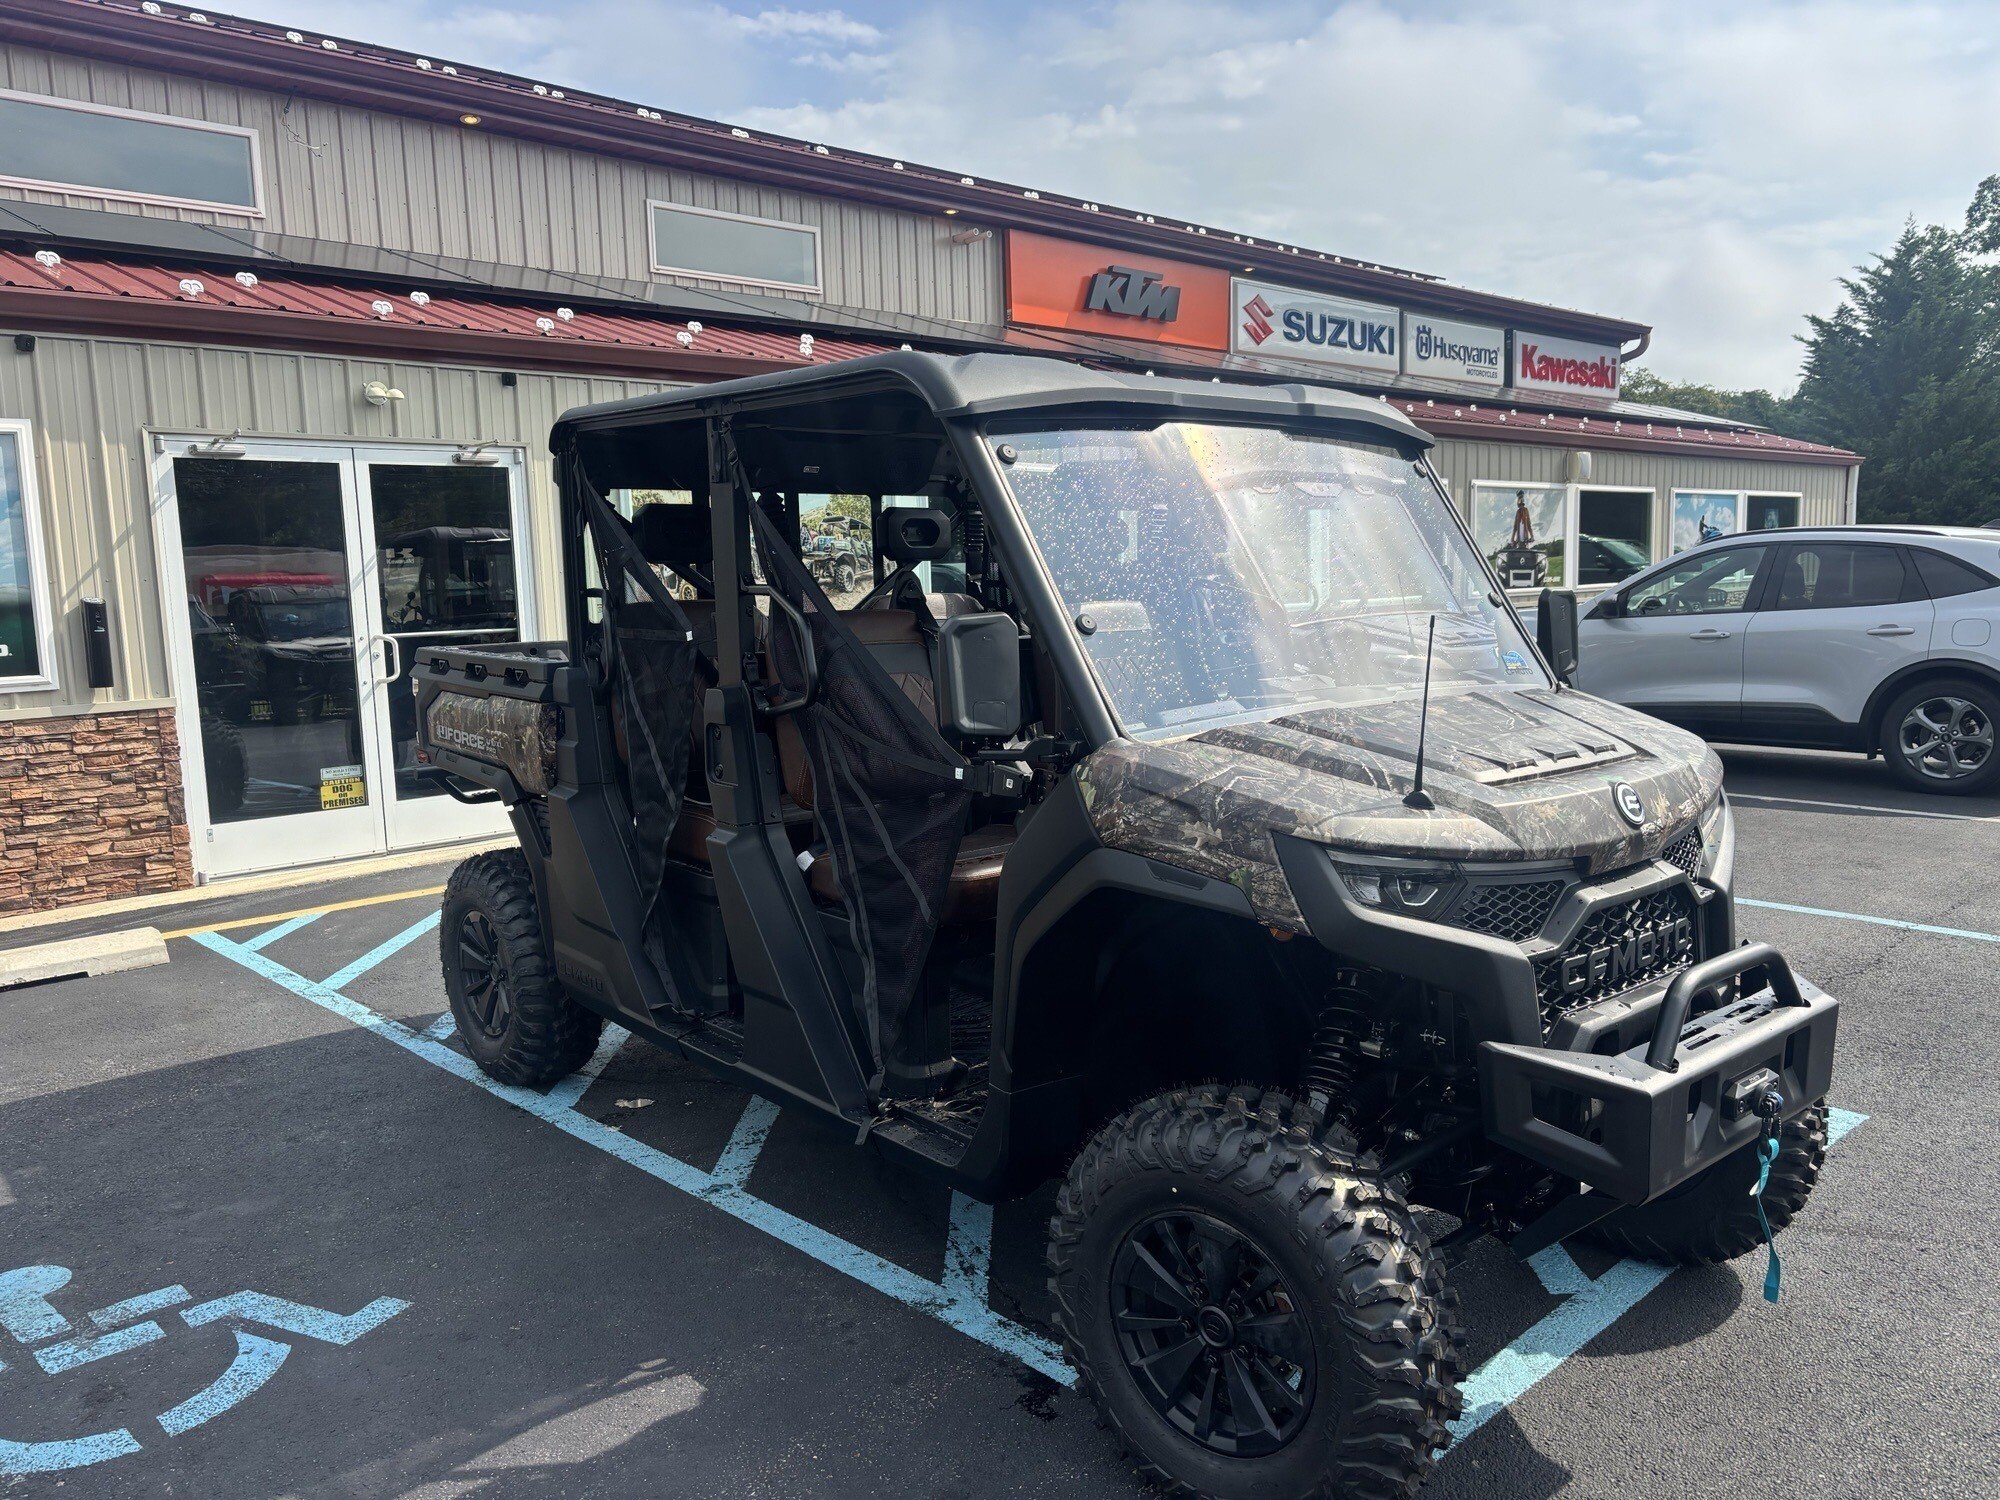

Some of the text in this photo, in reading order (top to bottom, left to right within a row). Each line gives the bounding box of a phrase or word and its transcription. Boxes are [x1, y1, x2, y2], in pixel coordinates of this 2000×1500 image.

[1084, 265, 1181, 323] KTM
[1282, 308, 1396, 356] SUZUKI
[1433, 335, 1499, 366] Husqvarna
[1466, 368, 1498, 379] MOTORCYCLES
[1521, 343, 1617, 390] Kawasaki
[437, 724, 485, 750] UFORCE
[322, 777, 361, 786] CAUTION
[332, 784, 353, 793] DOG
[323, 796, 364, 808] PREMISES
[1562, 917, 1691, 993] CFMOTO
